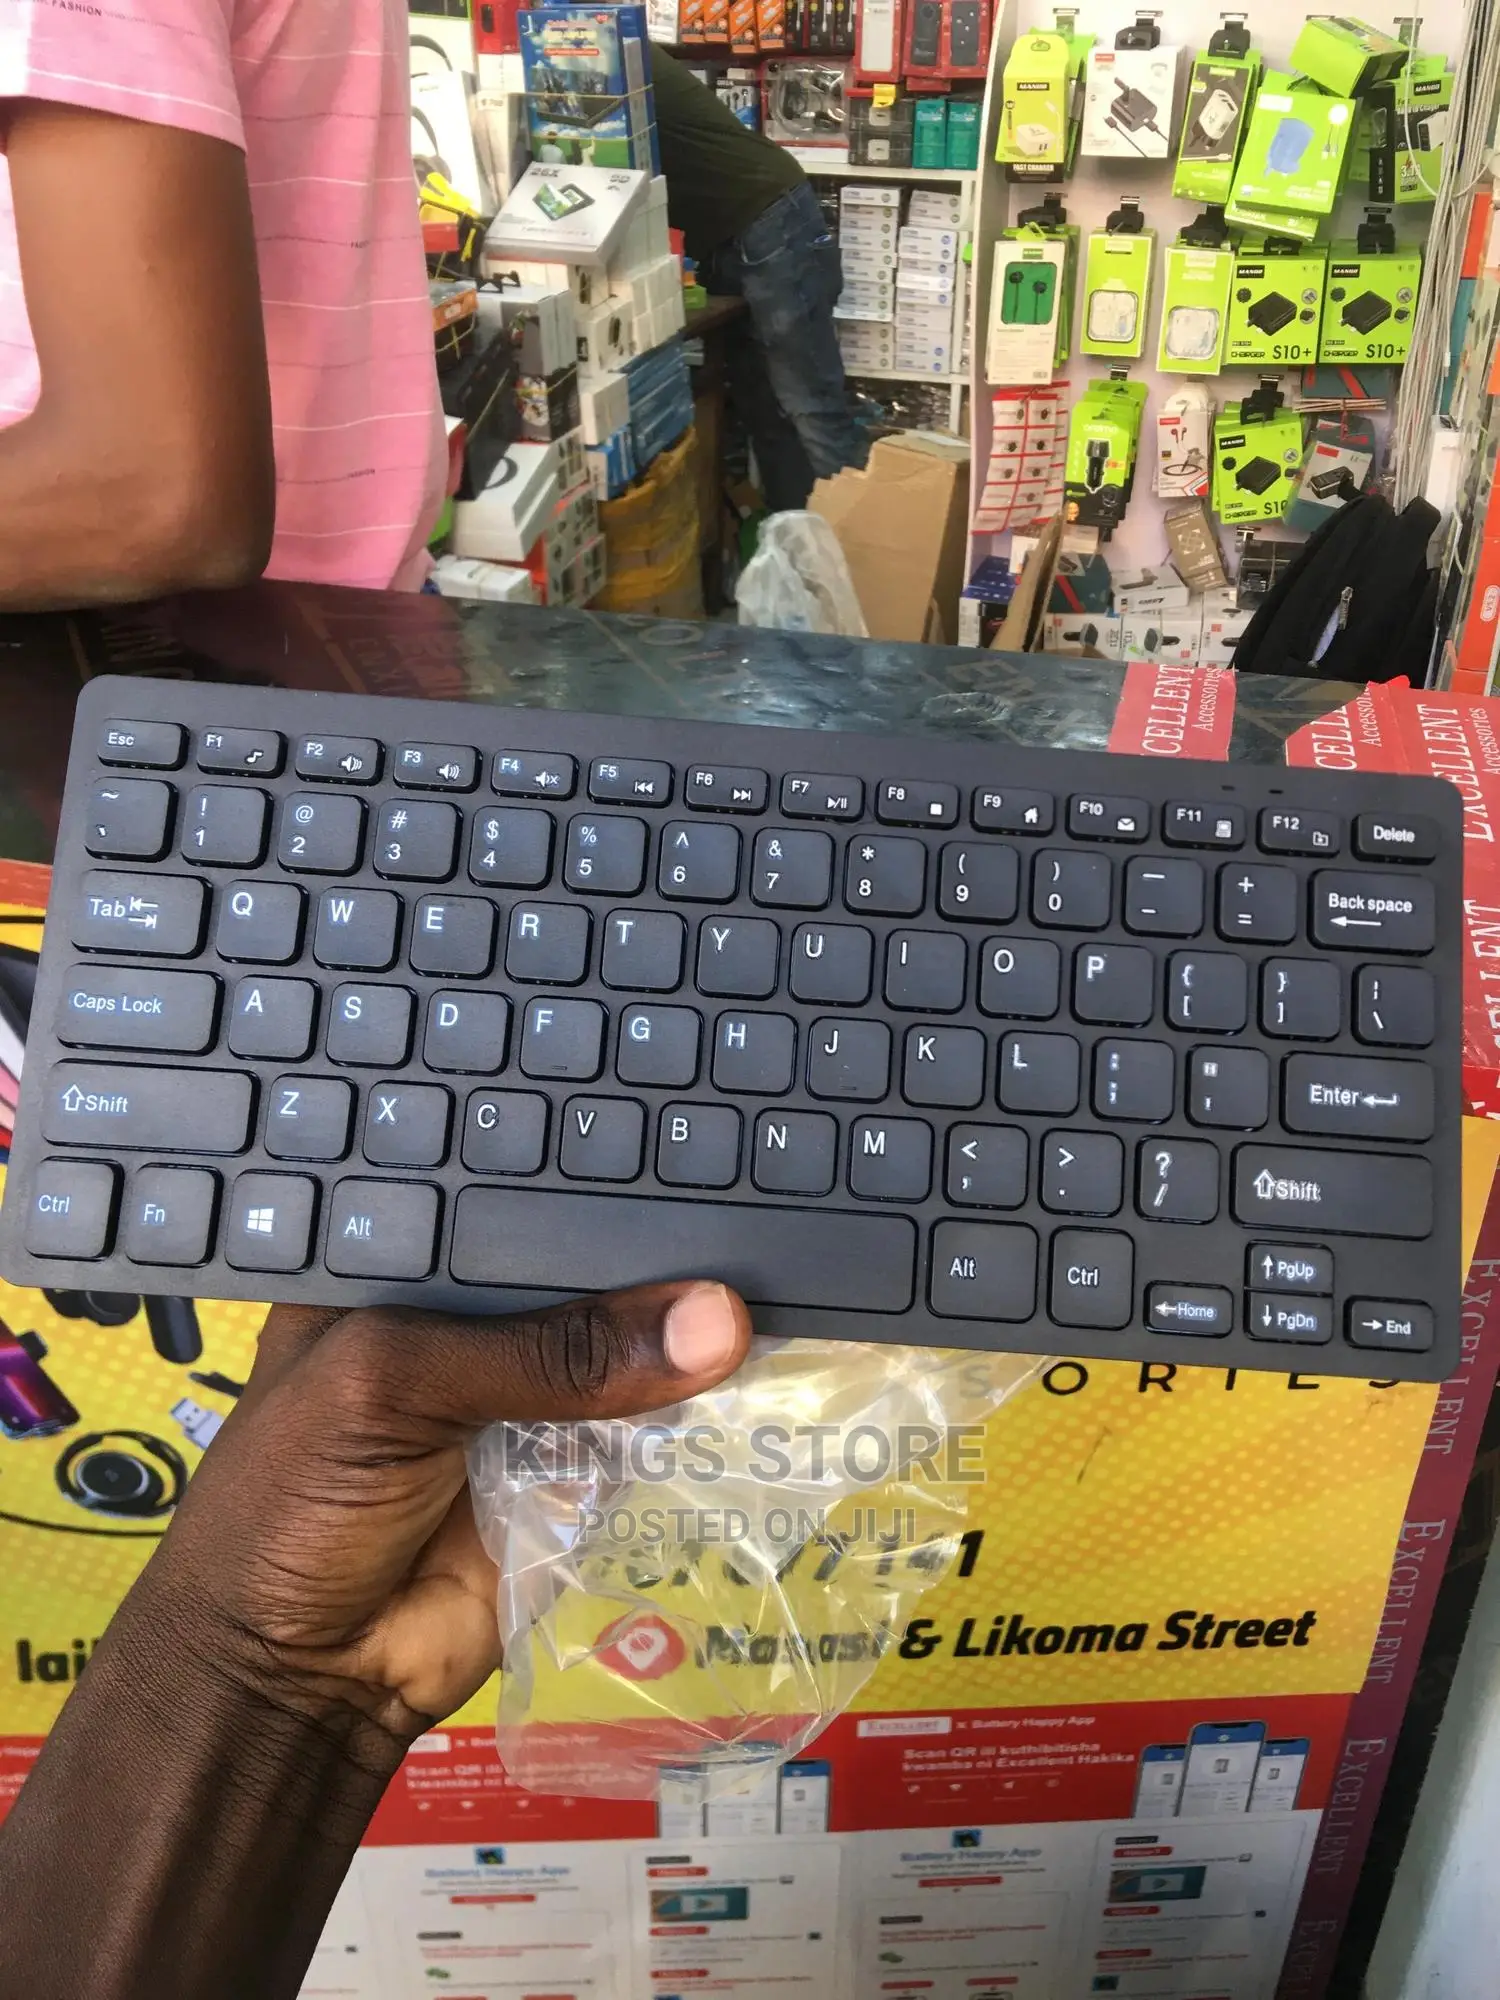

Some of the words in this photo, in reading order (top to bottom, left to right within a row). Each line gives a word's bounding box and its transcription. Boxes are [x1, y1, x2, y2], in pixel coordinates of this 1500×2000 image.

[50, 1, 102, 16] FASHION
[1272, 344, 1312, 360] S10+
[1366, 343, 1406, 359] S10+
[1191, 667, 1223, 732] Accessories
[108, 733, 135, 746] Esc
[206, 735, 222, 748] F1
[306, 743, 323, 756] F2
[404, 751, 421, 763] F3
[501, 758, 519, 772] F4
[600, 765, 617, 778] F5
[696, 772, 713, 786] F6
[791, 780, 809, 793] F7
[888, 786, 905, 800] F8
[983, 794, 1001, 808] F9
[1079, 801, 1103, 815] F10
[1176, 808, 1201, 821] F11
[1273, 815, 1299, 830] F12
[196, 830, 205, 846] 1
[1373, 825, 1415, 843] Delete
[292, 837, 305, 853] 2
[388, 844, 401, 859] 3
[484, 851, 496, 867] 4
[579, 859, 592, 875] 5
[674, 866, 686, 883] 6
[768, 873, 779, 889] 7
[858, 879, 872, 896] 8
[956, 885, 969, 902] 9
[90, 899, 126, 918] Tab
[231, 892, 253, 916] Q
[331, 900, 353, 922] W
[1048, 893, 1062, 911] 0
[1329, 893, 1364, 909] Back
[1368, 899, 1412, 913] space
[426, 907, 444, 930] E
[520, 913, 540, 937] R
[616, 921, 633, 944] T
[712, 928, 730, 951] Y
[805, 934, 823, 957] U
[994, 949, 1014, 973] O
[1087, 956, 1104, 979] P
[74, 993, 115, 1012] Caps
[123, 996, 161, 1013] Lock
[244, 990, 263, 1013] A
[344, 996, 362, 1019] S
[439, 1003, 458, 1026] D
[536, 1010, 553, 1032] F
[631, 1017, 650, 1040] G
[727, 1023, 746, 1047] H
[824, 1030, 838, 1054] J
[918, 1037, 935, 1061] K
[1013, 1044, 1027, 1067] L
[83, 1095, 128, 1113] Shift
[280, 1091, 299, 1115] Z
[1310, 1084, 1359, 1105] Enter
[378, 1097, 397, 1121] X
[477, 1104, 496, 1128] C
[577, 1111, 595, 1135] V
[671, 1118, 688, 1141] B
[767, 1125, 786, 1149] N
[864, 1131, 885, 1155] M
[1275, 1180, 1320, 1201] Shift
[38, 1194, 70, 1213] Ctrl
[144, 1204, 165, 1222] Fn
[344, 1217, 371, 1236] Alt
[950, 1257, 976, 1278] Alt
[1067, 1266, 1098, 1286] Ctrl
[1278, 1261, 1314, 1280] PgUp
[1176, 1303, 1214, 1318] Home
[1278, 1312, 1314, 1330] PgDn
[1386, 1320, 1411, 1335] End
[1366, 1518, 1447, 1685] EXCELLENT
[898, 1618, 942, 1659] &
[953, 1614, 1149, 1657] Likoma
[1156, 1610, 1318, 1651] Street
[16, 1637, 100, 1682] lai
[1314, 1736, 1388, 1876] EXCELLENT
